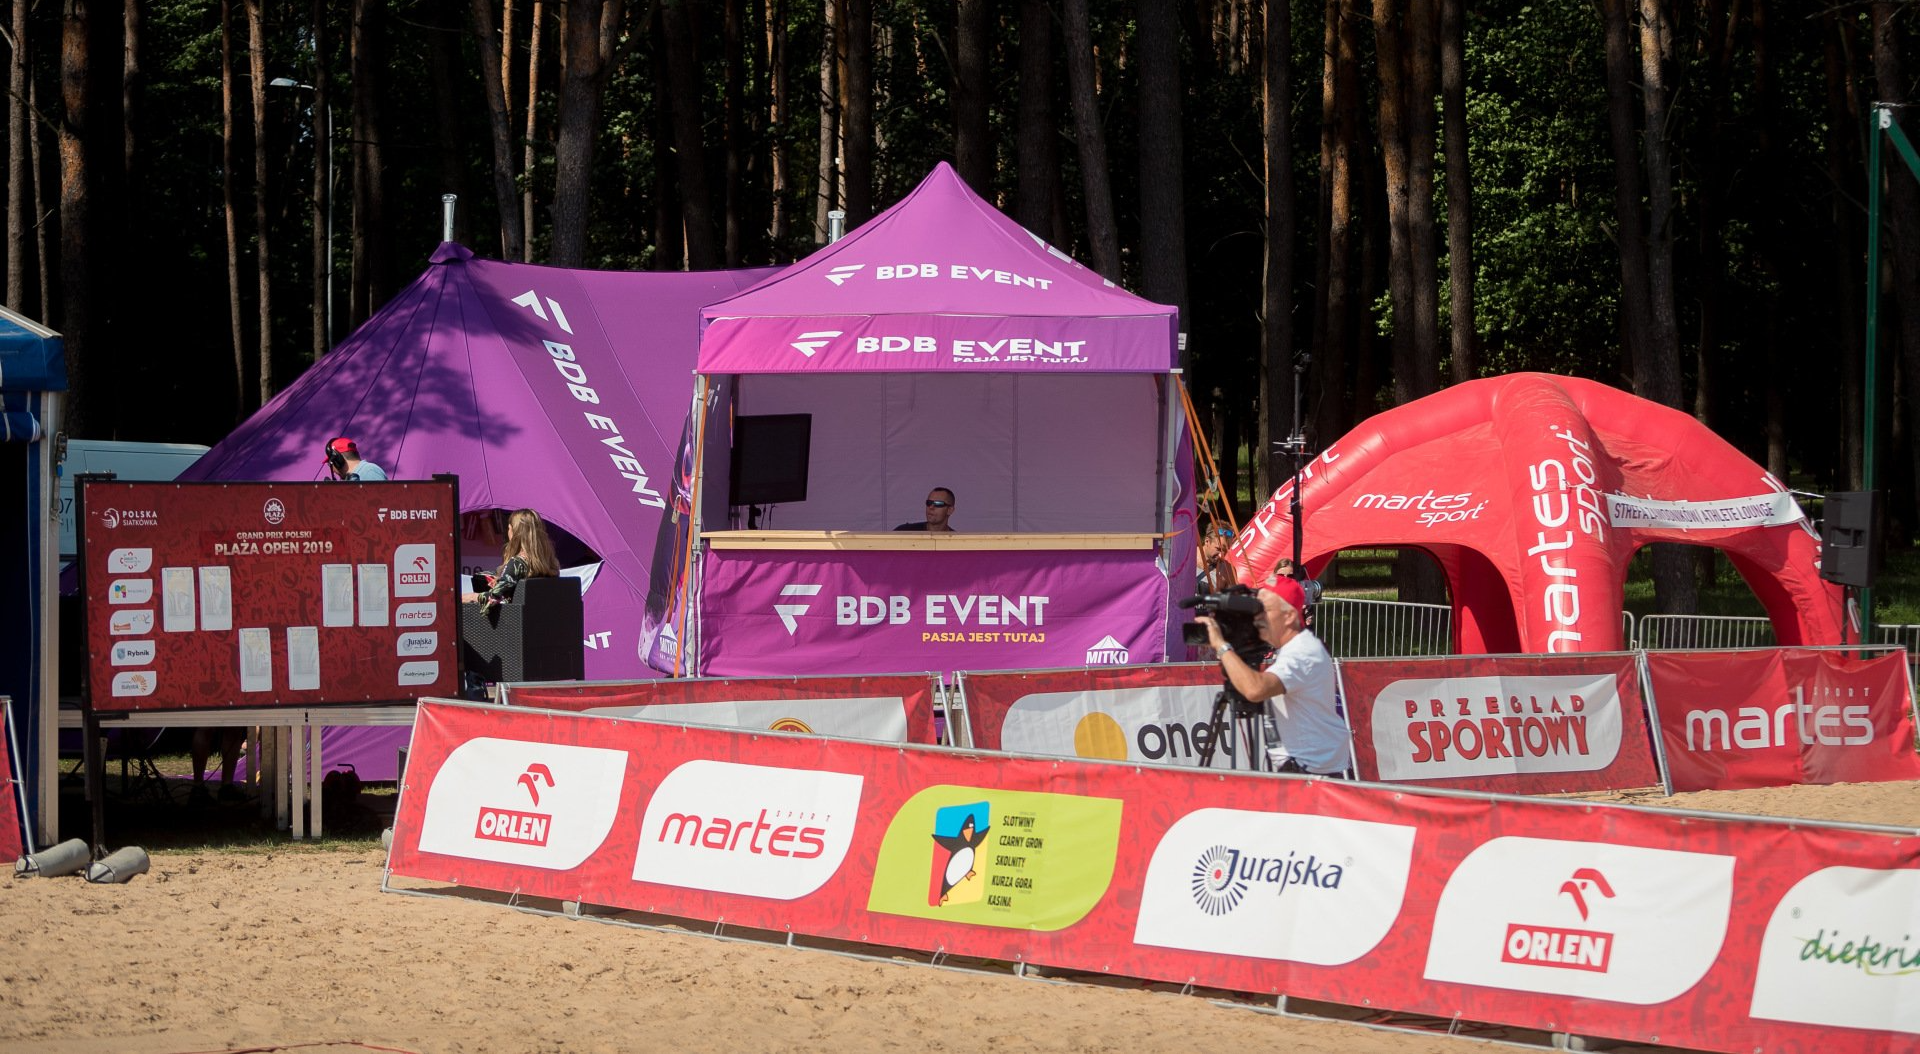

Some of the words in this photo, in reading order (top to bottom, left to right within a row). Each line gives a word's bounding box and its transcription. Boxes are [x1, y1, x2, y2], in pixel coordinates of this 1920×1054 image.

[876, 263, 939, 280] BDB
[950, 264, 1053, 290] EVENT
[856, 335, 937, 354] BDB
[952, 338, 1086, 357] EVENT
[953, 355, 1000, 363] PASJA
[1003, 354, 1037, 362] JEST
[541, 339, 600, 405] BDB
[583, 411, 667, 510] EVENT
[1352, 489, 1473, 510] martes
[122, 510, 158, 519] POLSKA
[122, 518, 158, 526] SIATKÓWKA
[390, 510, 408, 520] BDB
[410, 509, 438, 520] EVENT
[1415, 502, 1485, 528] sport
[1703, 507, 1740, 523] ATHLETE
[1737, 502, 1775, 519] LOUNGE
[236, 531, 264, 539] GRAND
[265, 531, 284, 539] PRIX
[285, 530, 312, 539] POLSKI
[214, 539, 260, 556] PLAŻA
[263, 542, 300, 555] OPEN
[302, 541, 333, 554] 2019
[401, 575, 429, 583] ORLEN
[399, 610, 433, 619] martes
[836, 595, 911, 626] BDB
[925, 594, 1050, 626] EVENT
[922, 632, 966, 643] PASJA
[968, 632, 1001, 643] JEST
[1002, 632, 1046, 643] TUTAJ
[127, 650, 150, 658] Rybnik
[1086, 651, 1129, 665] MITKO
[1404, 695, 1585, 719] PRZEGLĄD
[1685, 685, 1875, 752] martes
[1407, 715, 1590, 764] SPORTOWY
[480, 811, 548, 842] ORLEN
[658, 808, 825, 859] martes
[999, 835, 1025, 848] CZARNY
[991, 875, 1014, 888] KURZA
[1215, 848, 1343, 897] Jurajska
[1507, 928, 1607, 968] ORLEN
